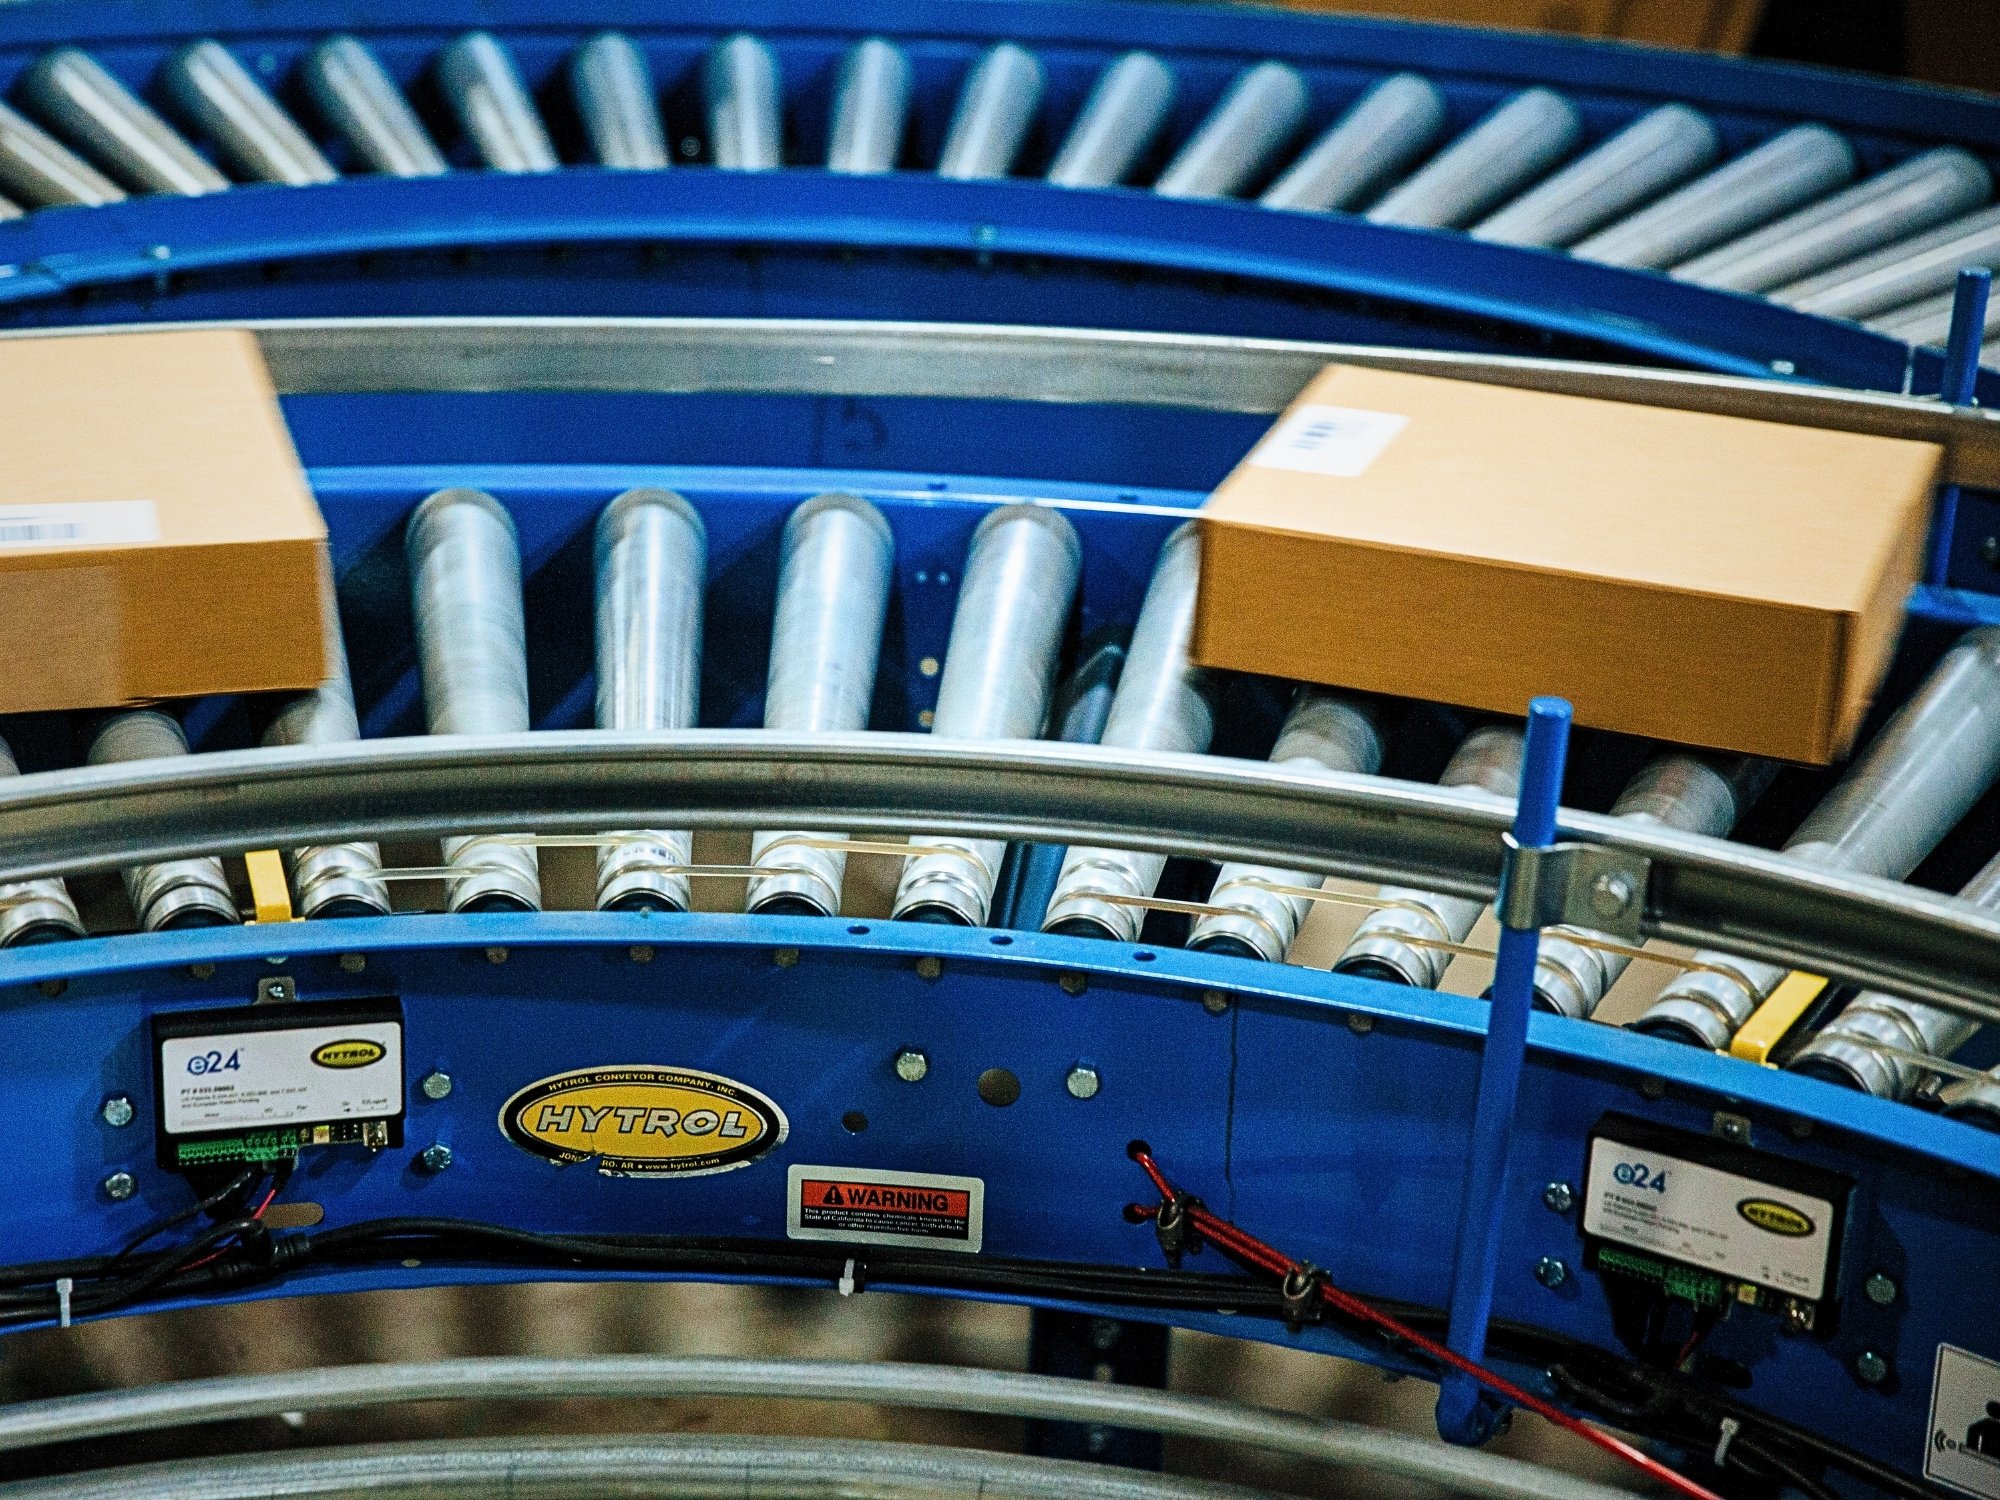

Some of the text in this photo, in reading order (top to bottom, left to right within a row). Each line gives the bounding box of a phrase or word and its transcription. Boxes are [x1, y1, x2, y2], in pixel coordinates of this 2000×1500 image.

[548, 1076, 592, 1091] HYTROL
[595, 1072, 655, 1082] CONVEYOR
[716, 1084, 738, 1097] INC.
[536, 1105, 748, 1138] HYTROL
[621, 1162, 634, 1170] AR
[645, 1157, 720, 1170] www.hytrol.com
[847, 1187, 949, 1212] WARNING
[831, 1215, 864, 1223] California
